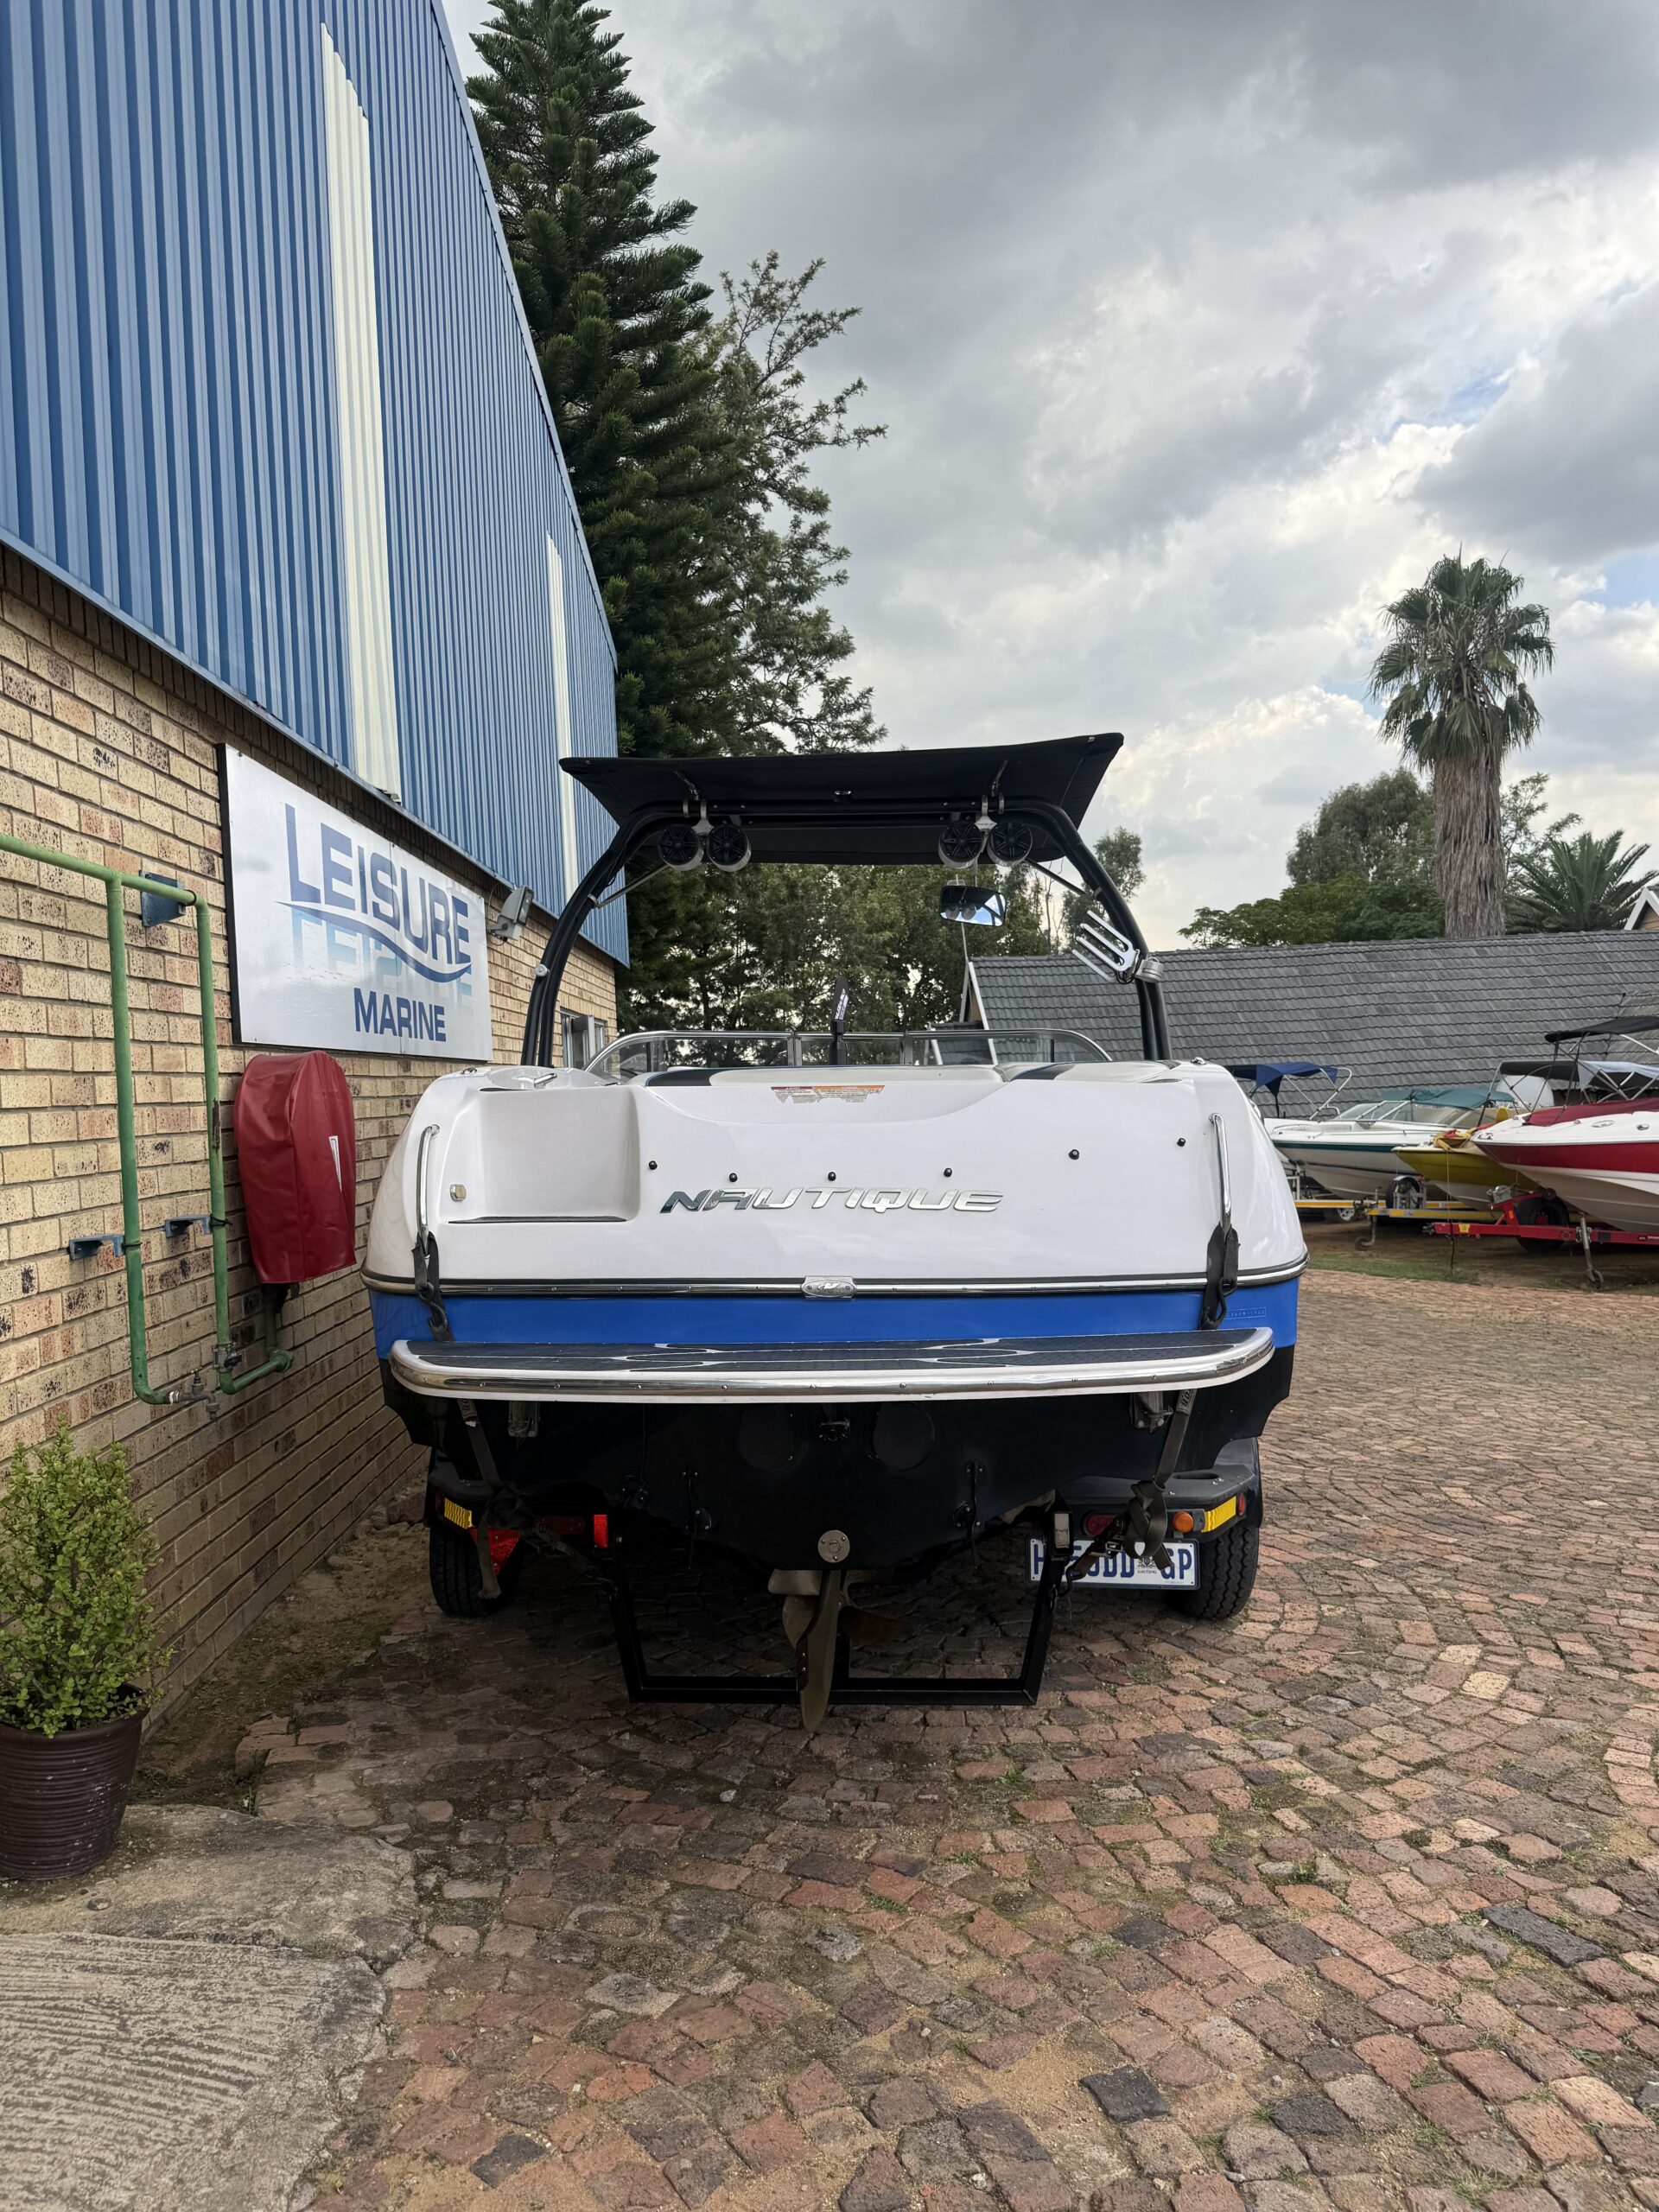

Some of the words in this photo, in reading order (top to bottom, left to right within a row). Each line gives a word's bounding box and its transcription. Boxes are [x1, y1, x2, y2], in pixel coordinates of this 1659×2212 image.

[284, 803, 472, 965] LEISURE
[353, 988, 447, 1042] MARINE
[659, 1187, 1004, 1214] NAUTIQUE
